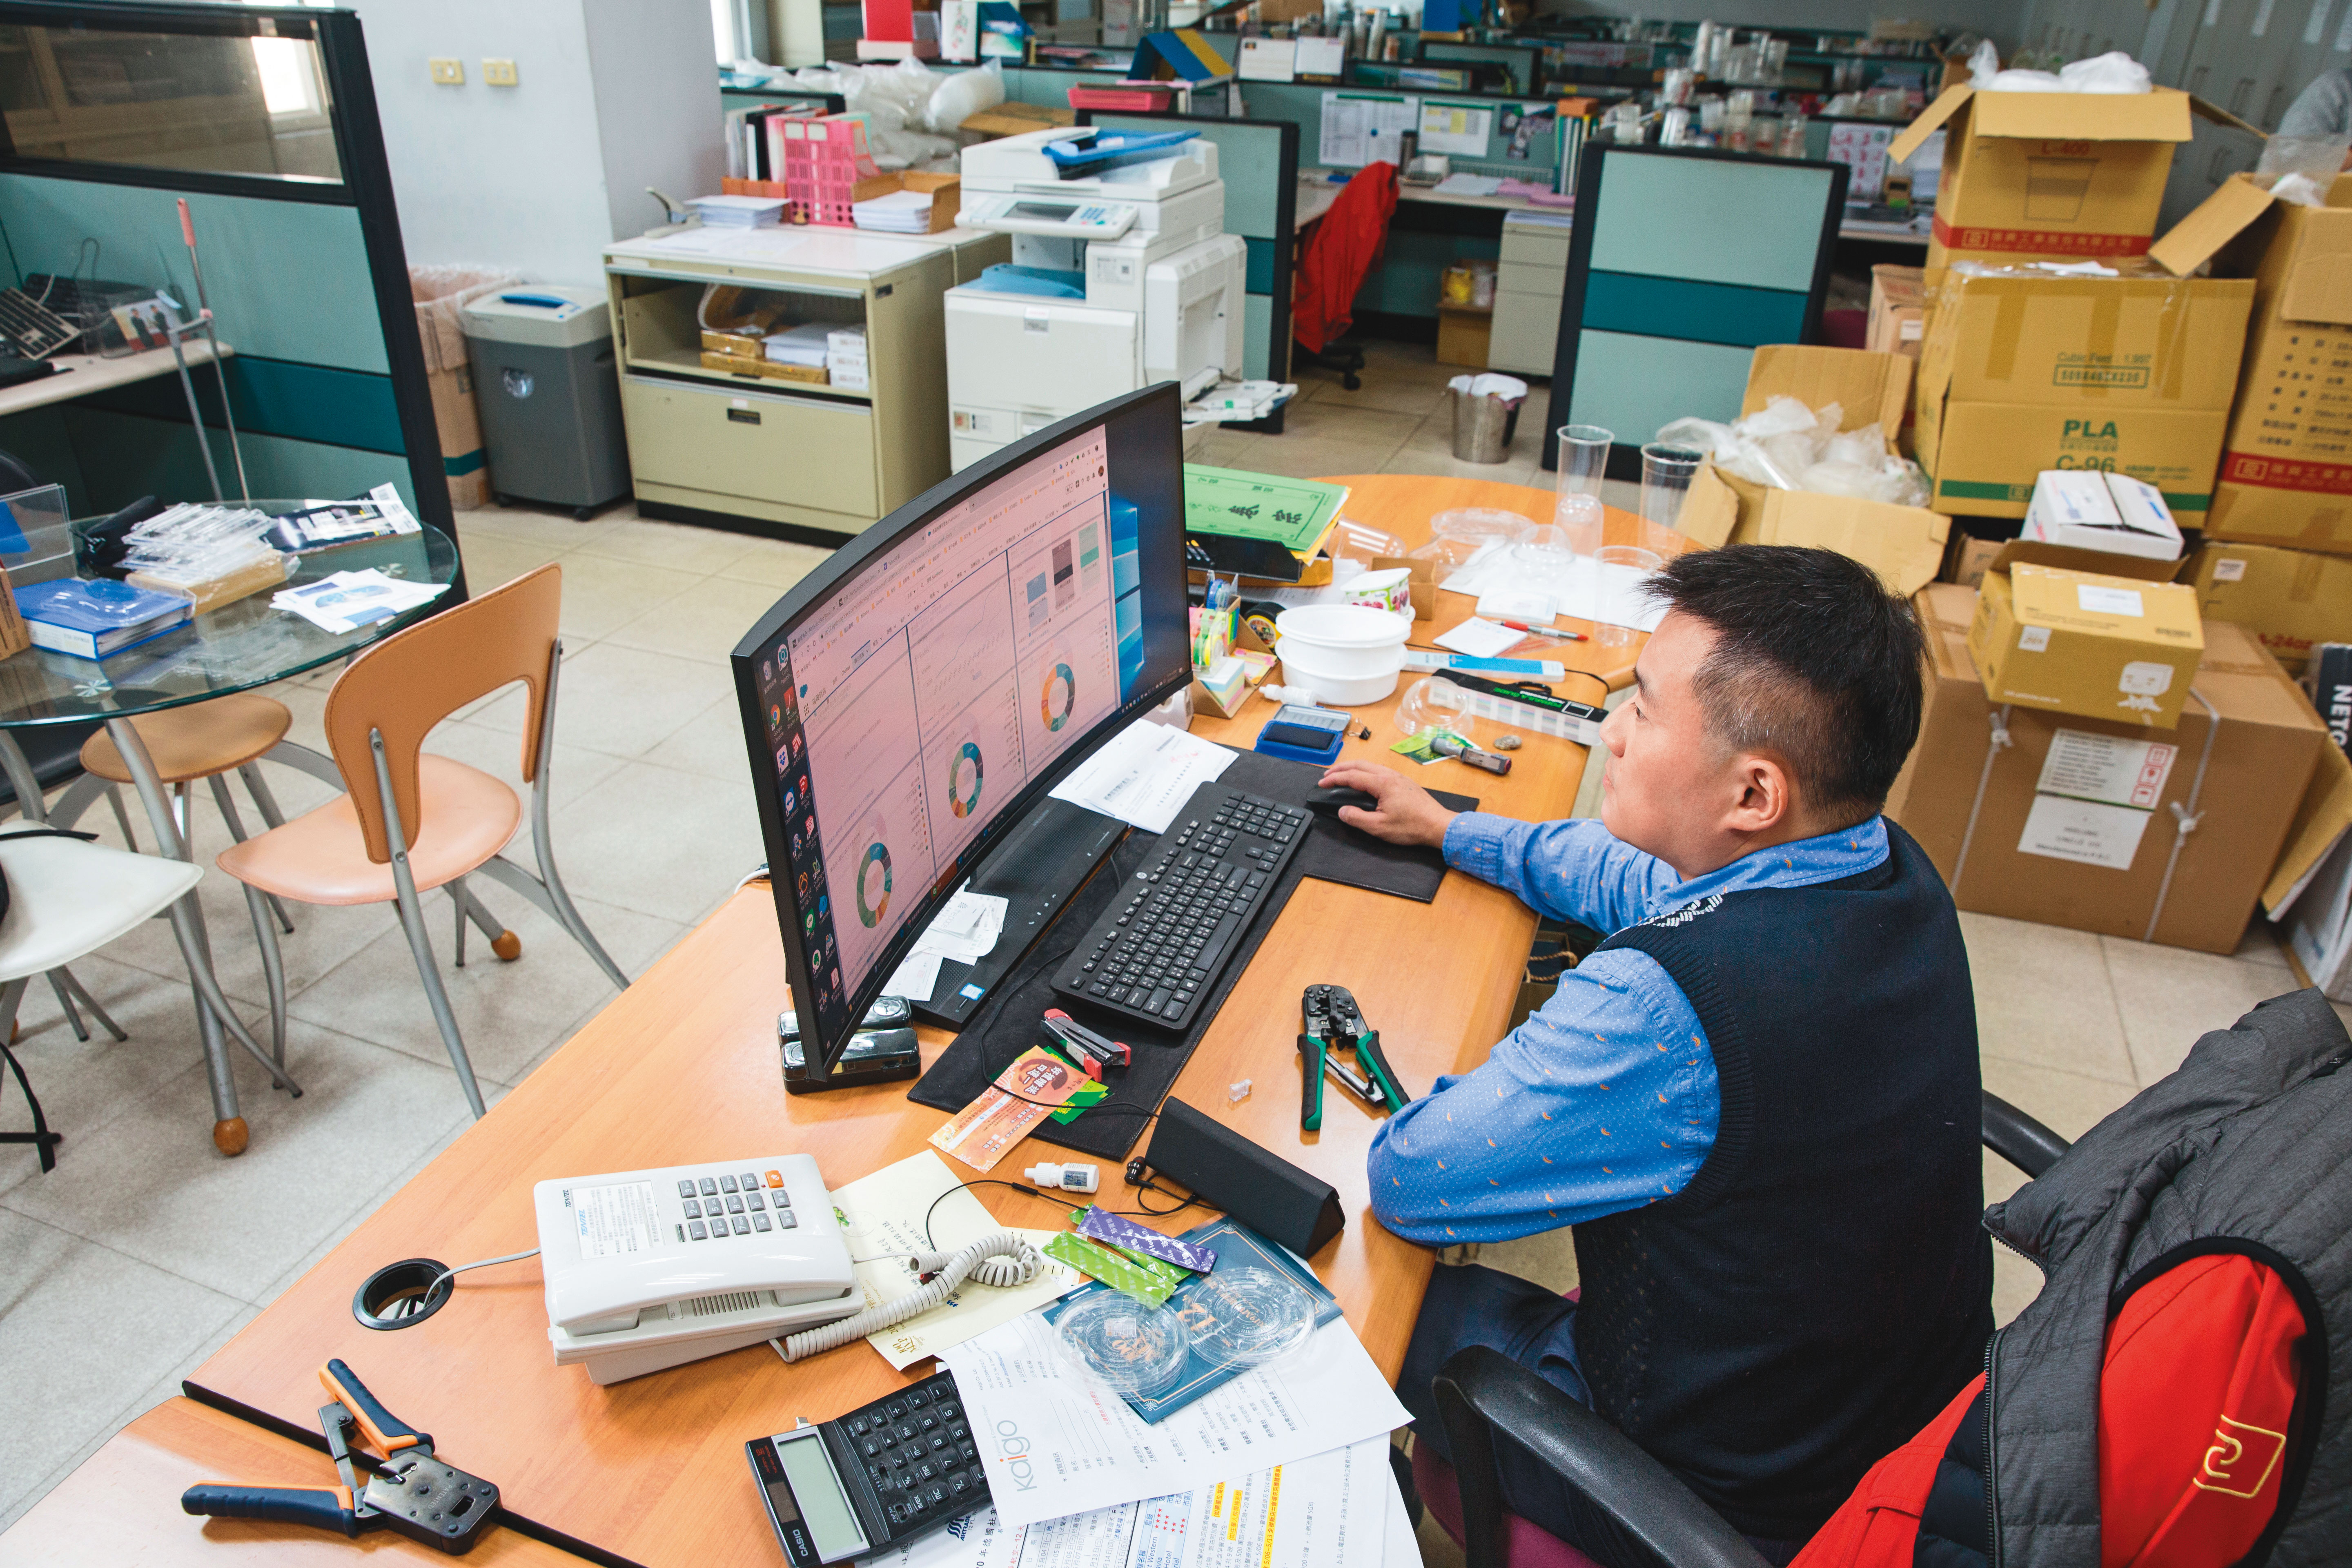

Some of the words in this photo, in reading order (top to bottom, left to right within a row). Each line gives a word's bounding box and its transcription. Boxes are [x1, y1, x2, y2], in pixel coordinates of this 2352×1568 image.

[2063, 420, 2118, 439] PLA
[2056, 455, 2115, 472] C-96
[841, 665, 851, 676] Chatter
[1494, 687, 1520, 698] GUIDE
[1521, 692, 1563, 708] FORMULA
[773, 725, 782, 737] Google
[785, 807, 800, 825] TeamViewer
[1022, 1063, 1048, 1085] 四選一
[1023, 1063, 1063, 1096] 好禮贈送
[563, 1189, 571, 1208] TENTEL
[578, 1208, 588, 1236] TENTEL
[783, 1212, 792, 1223] 保留
[1091, 1216, 1105, 1238] Herbelle
[892, 1340, 907, 1355] 100
[1013, 1359, 1025, 1379] 公司資訊
[875, 1415, 882, 1423] GT
[924, 1419, 933, 1427] 9
[902, 1425, 911, 1437] M+
[867, 1442, 875, 1454] TAX-
[913, 1445, 921, 1456] M-
[990, 1415, 1041, 1495] kaigo
[921, 1464, 931, 1477] MR
[1052, 1451, 1065, 1476] 展覽資訊
[904, 1476, 911, 1484] %
[956, 1479, 965, 1490] +/-
[427, 1484, 453, 1511] PATENTED
[914, 1494, 923, 1509] M/EX
[932, 1488, 942, 1500] MC
[1307, 1501, 1315, 1514] 5GB)
[960, 1514, 971, 1541] AIRTRADE
[1145, 1513, 1154, 1526] 星級
[1304, 1514, 1313, 1537] 上網流量
[1114, 1517, 1124, 1539] 法蘭克福
[793, 1528, 808, 1557] CASIO
[1147, 1536, 1158, 1559] Western
[1254, 1542, 1263, 1556] 5/06
[1263, 1534, 1273, 1564] 5/06~5/13
[1164, 1550, 1173, 1568] Hotel
